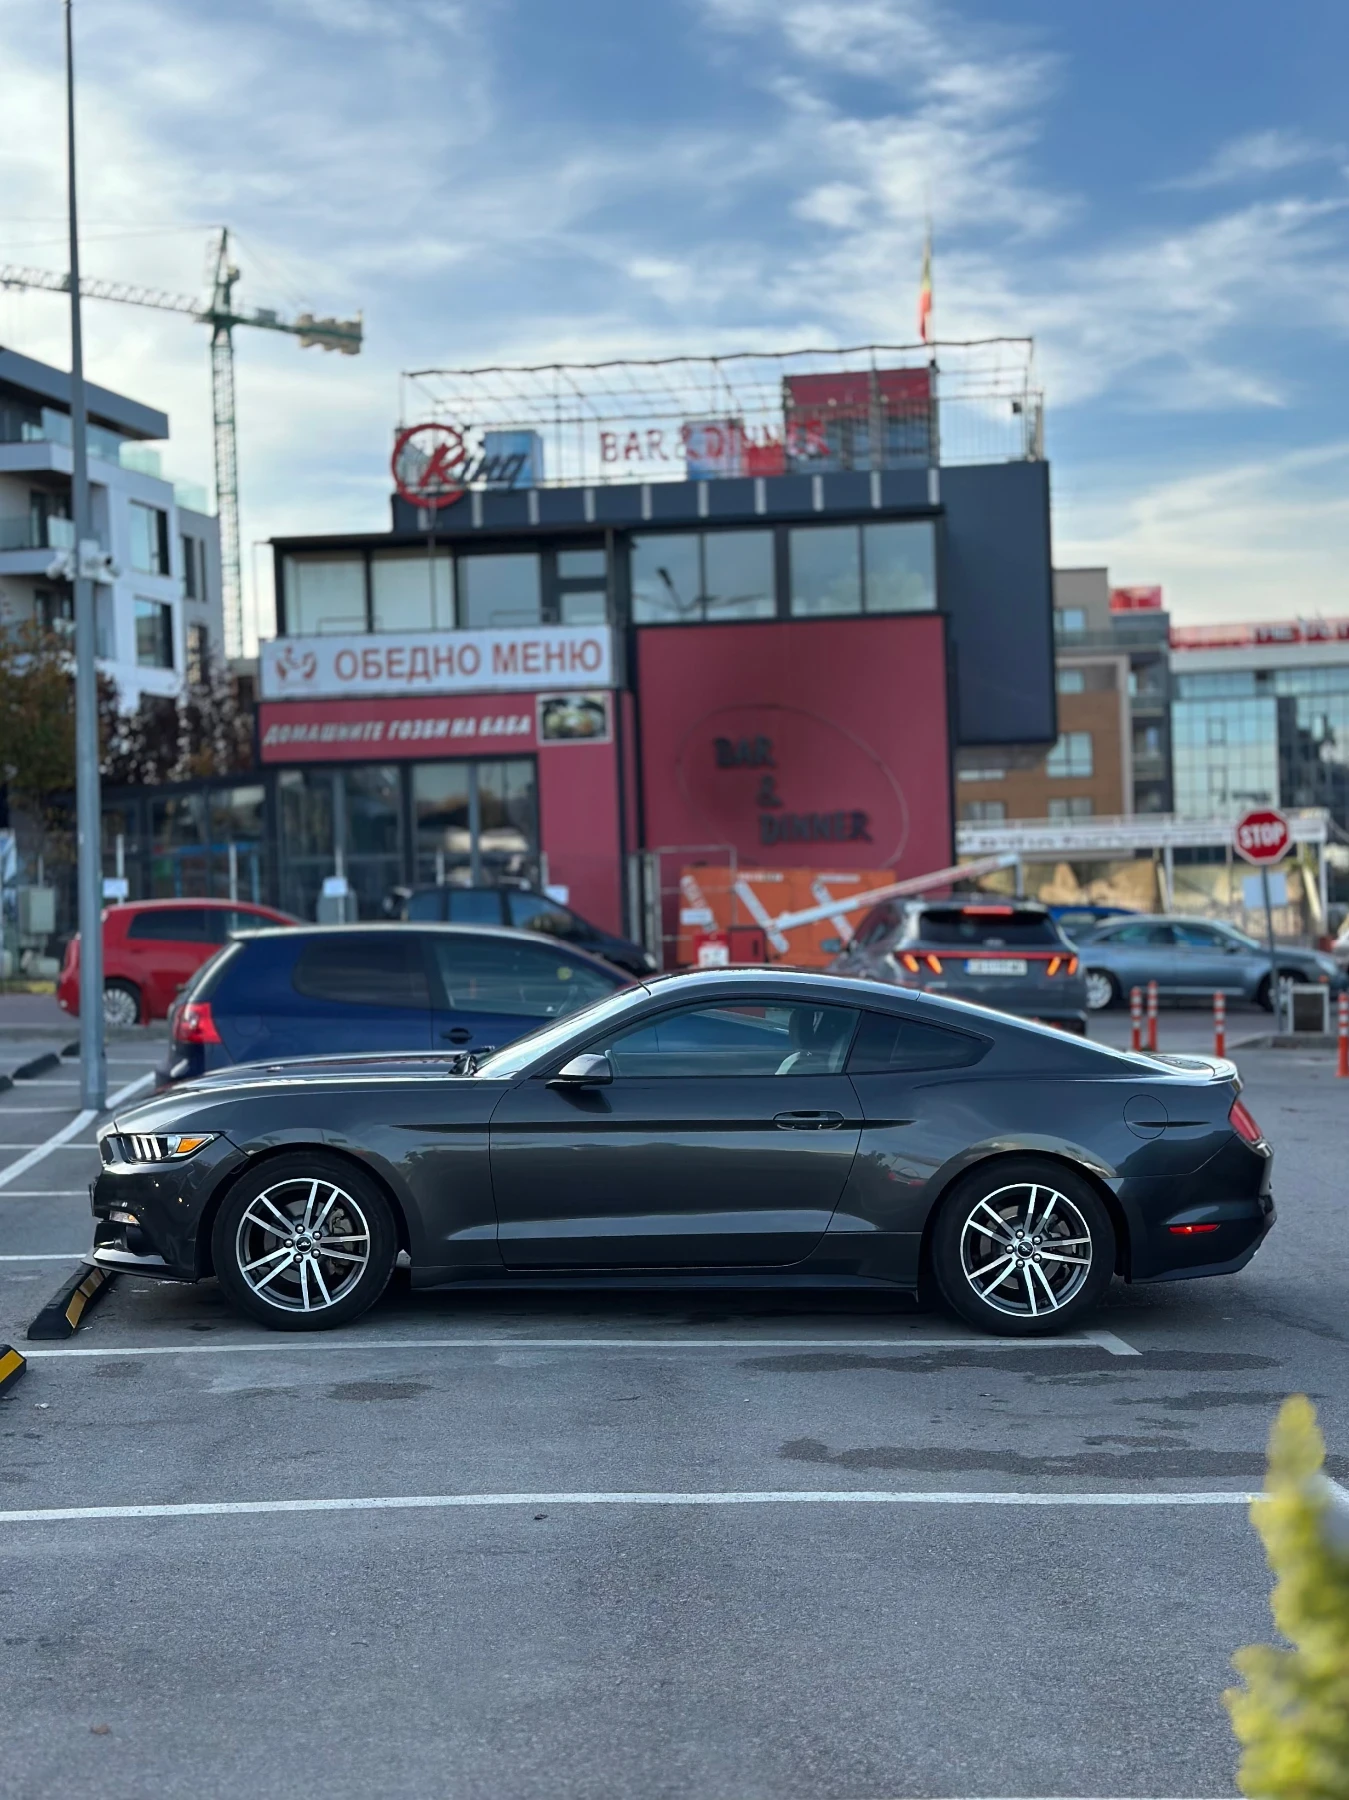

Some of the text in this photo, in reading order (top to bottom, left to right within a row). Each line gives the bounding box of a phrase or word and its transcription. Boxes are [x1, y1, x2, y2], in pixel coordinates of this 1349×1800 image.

[600, 429, 668, 462] BAR
[703, 419, 830, 459] DINNER
[333, 638, 603, 684] ОБЕДНО МЕНЮ
[261, 714, 532, 748] ДОМАШНИТЕ ГОЗБИ НА БАБА
[714, 732, 777, 769] BAR
[757, 774, 783, 808] &
[759, 809, 874, 846] DINNER
[1240, 821, 1285, 849] STOP
